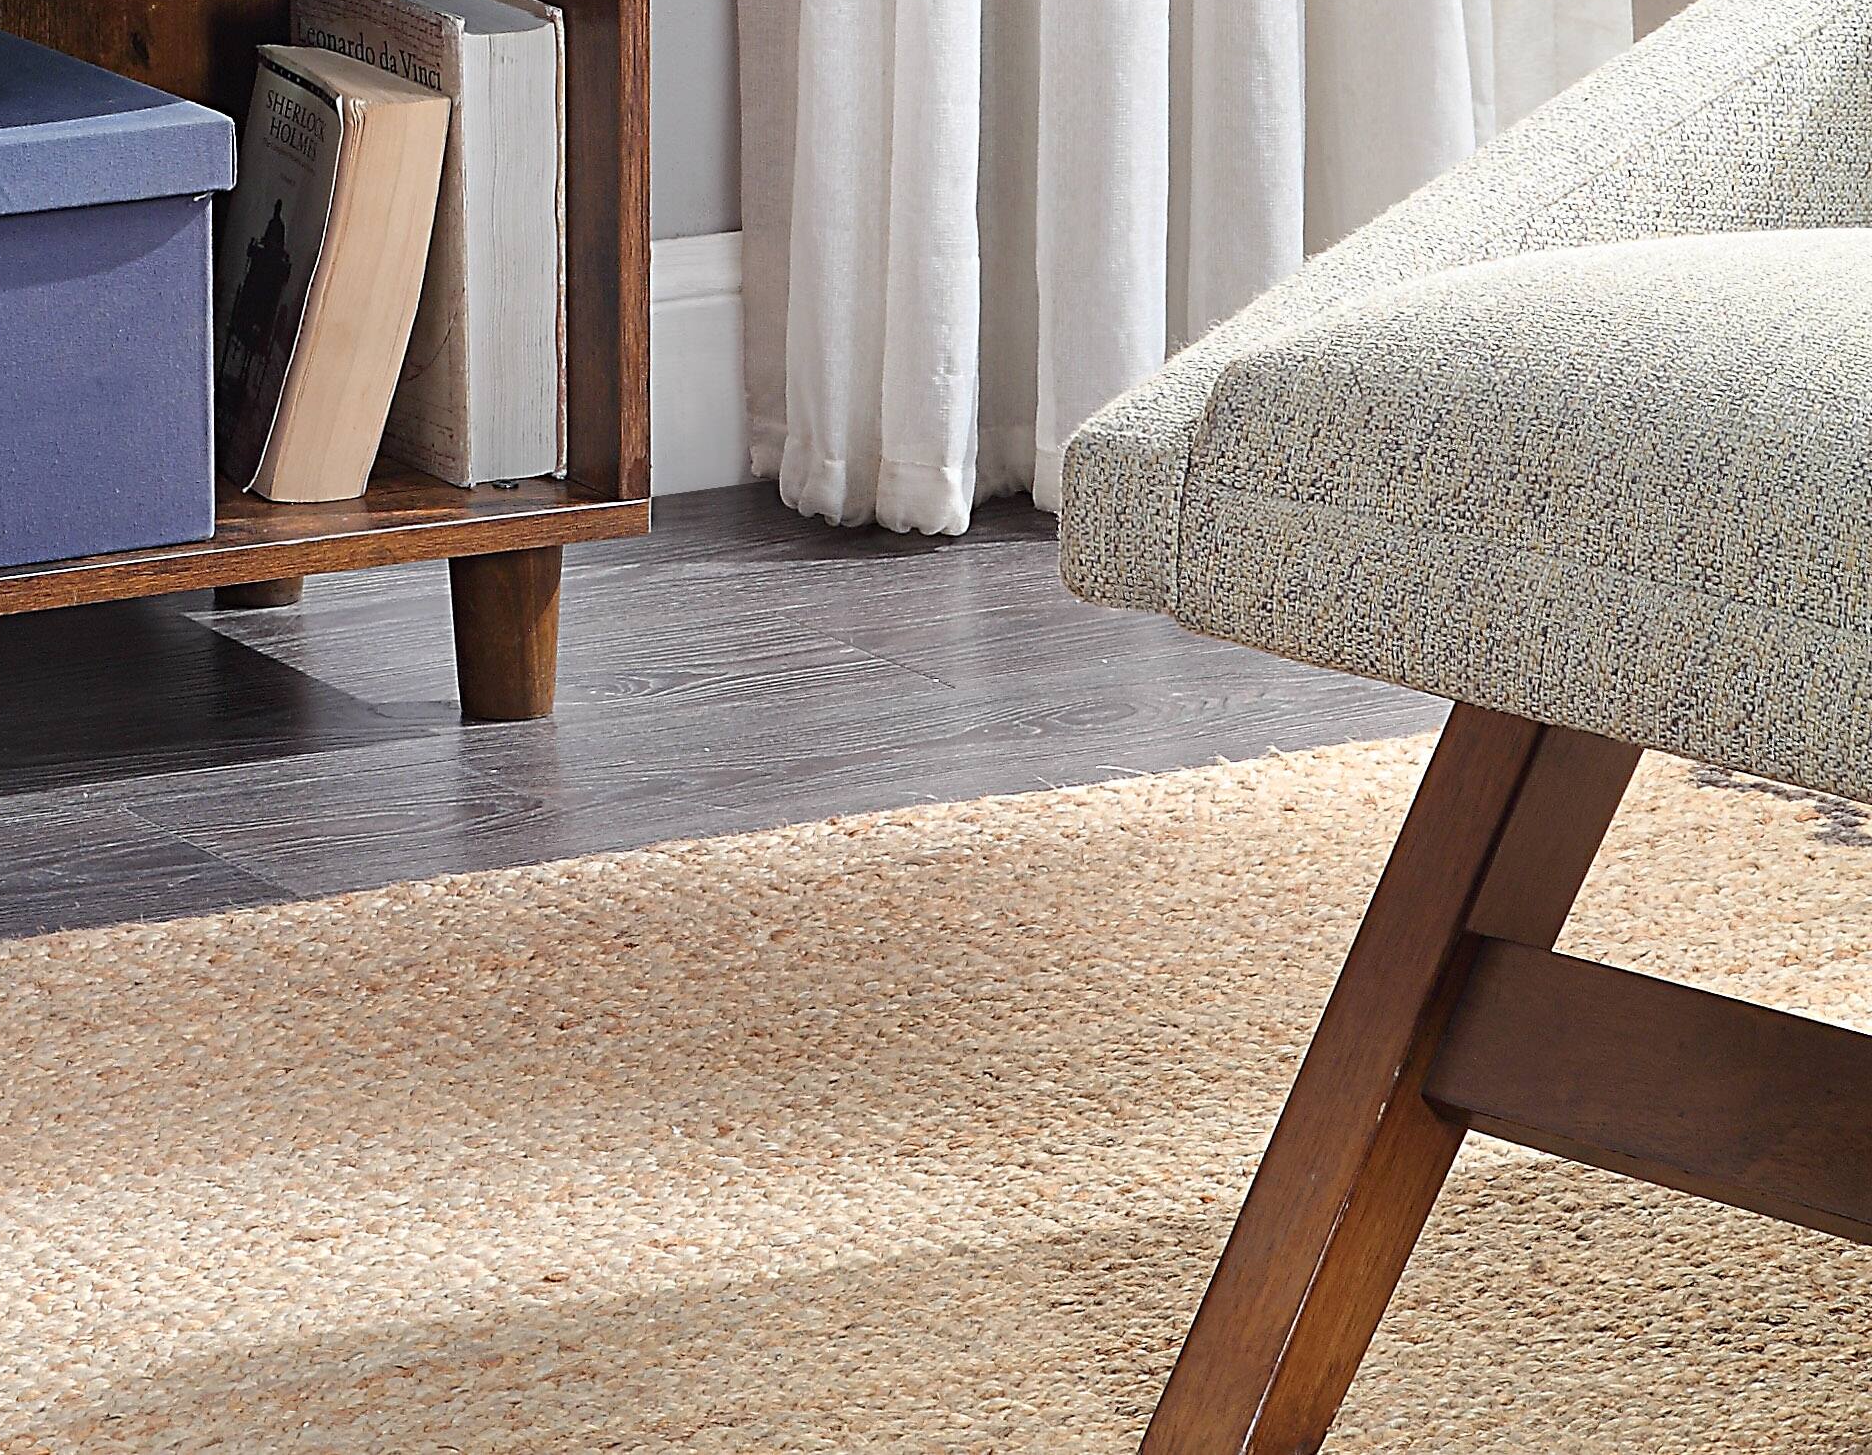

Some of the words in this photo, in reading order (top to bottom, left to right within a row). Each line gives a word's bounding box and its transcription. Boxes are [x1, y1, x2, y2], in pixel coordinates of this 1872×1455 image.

[298, 20, 375, 65] Leonardo
[379, 41, 398, 74] da
[399, 50, 443, 91] Vinci
[267, 90, 327, 143] SHERLOCK
